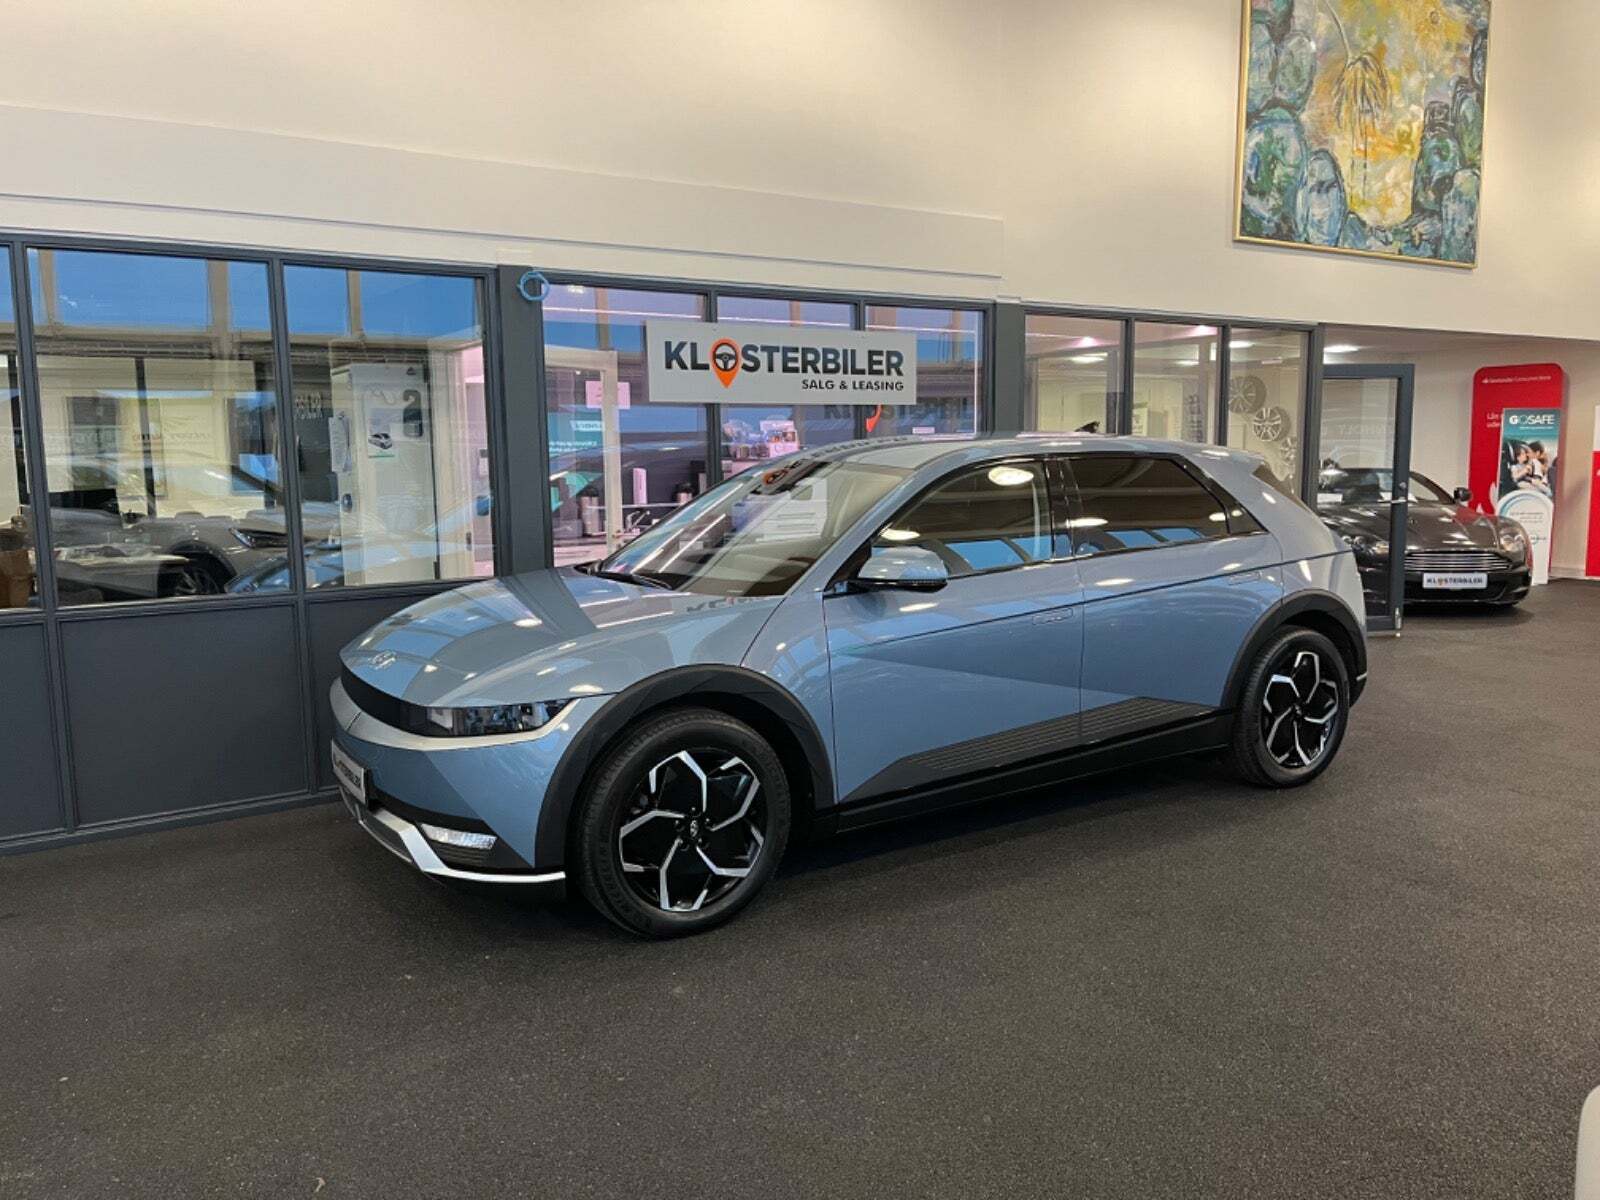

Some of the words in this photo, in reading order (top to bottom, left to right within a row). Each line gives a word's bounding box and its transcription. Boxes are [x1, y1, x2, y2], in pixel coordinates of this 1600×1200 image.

[664, 340, 904, 377] KLOSTERBILER
[802, 380, 834, 390] SALG
[840, 381, 848, 390] &
[853, 381, 904, 392] LEASING
[1509, 414, 1555, 425] GOSAFE
